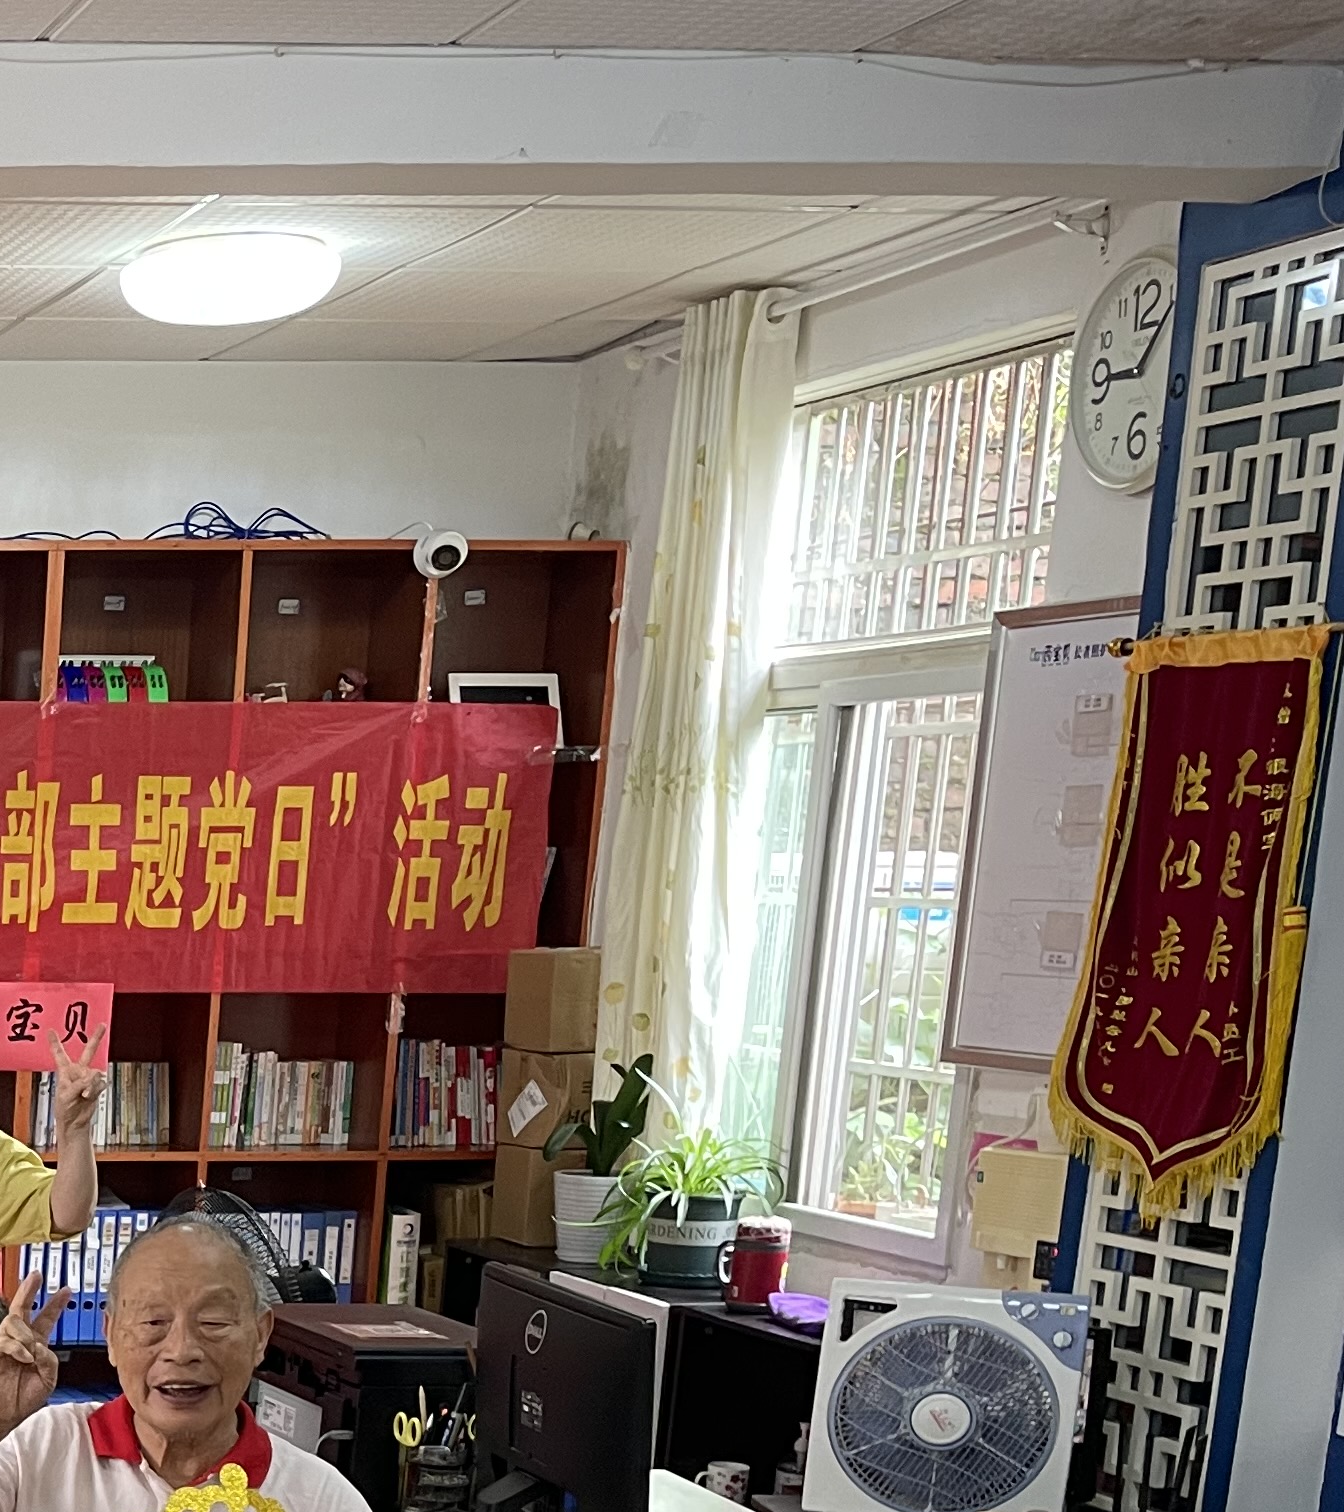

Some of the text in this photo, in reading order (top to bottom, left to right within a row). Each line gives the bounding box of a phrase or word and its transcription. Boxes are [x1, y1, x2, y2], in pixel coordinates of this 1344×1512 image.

[1118, 298, 1128, 319] 11
[1134, 279, 1161, 332] 12
[1100, 330, 1112, 351] 10
[1091, 358, 1111, 405] 9
[1094, 412, 1102, 431] 8
[1127, 411, 1147, 461] 6
[1111, 436, 1119, 456] 7
[1133, 751, 1212, 1057] 胜似亲人
[1184, 749, 1262, 1058] 不是亲人
